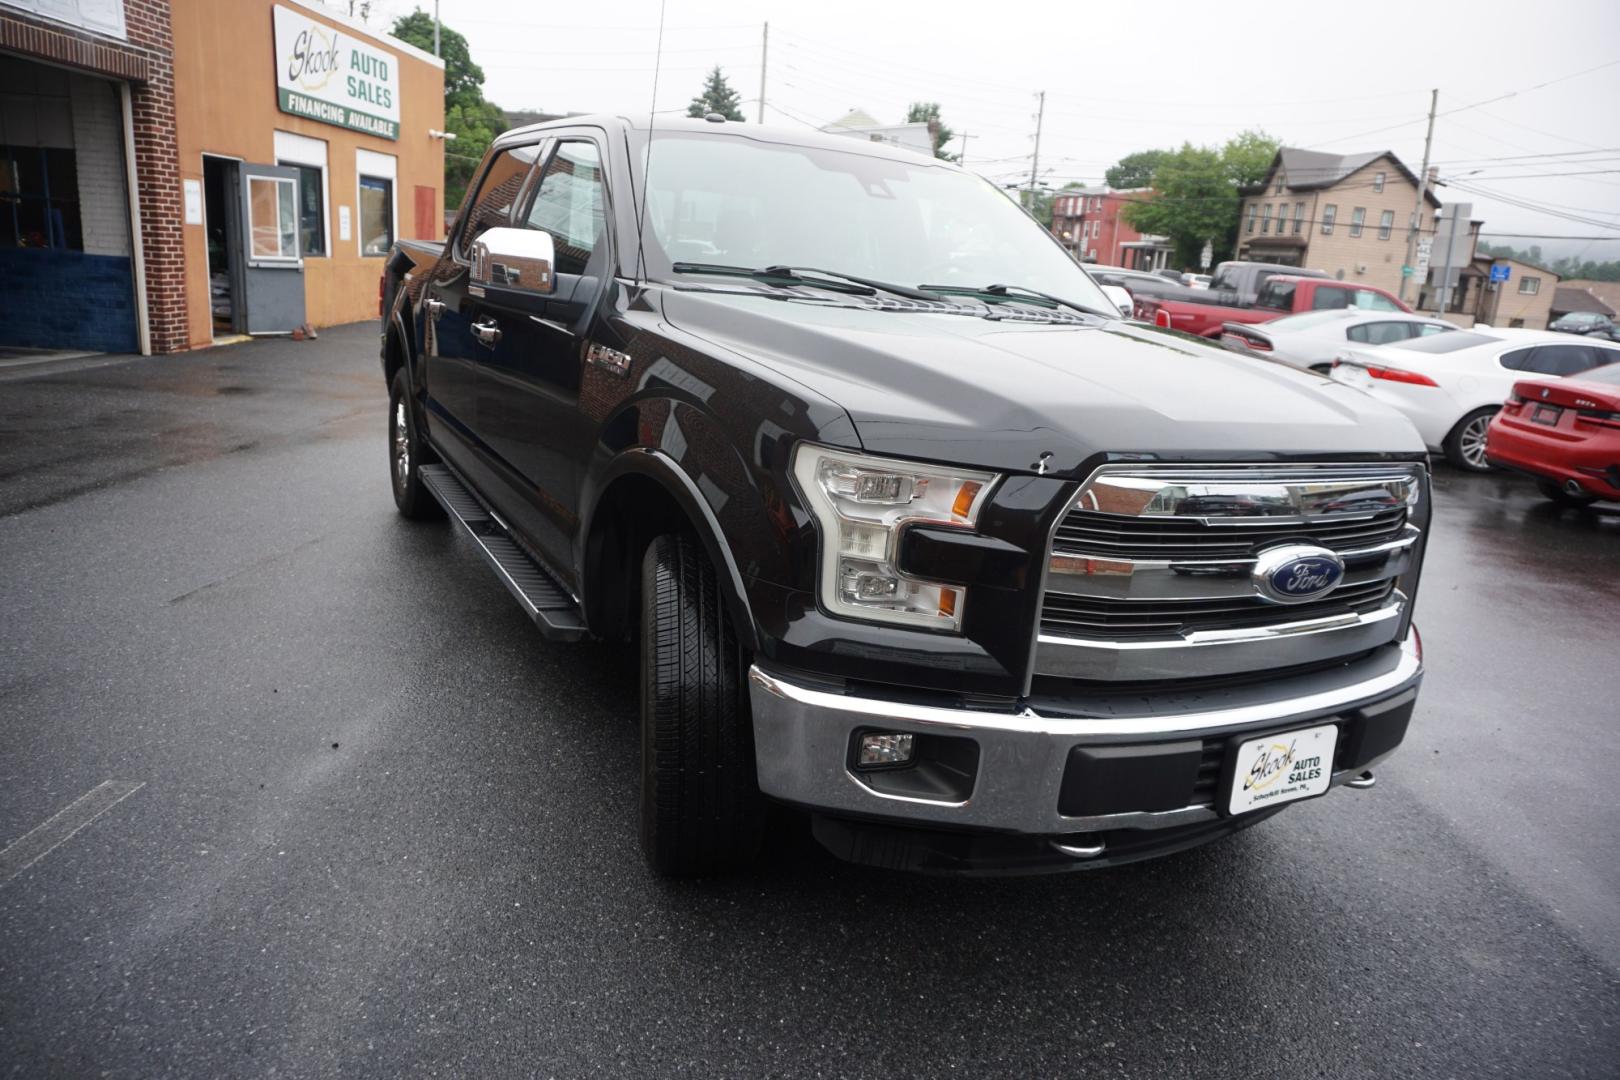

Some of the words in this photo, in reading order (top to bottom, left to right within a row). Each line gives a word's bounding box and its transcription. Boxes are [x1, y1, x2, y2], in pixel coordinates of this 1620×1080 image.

[288, 30, 339, 82] Skook
[350, 48, 388, 82] AUTO
[347, 75, 392, 109] SALES
[288, 93, 345, 124] FINANCING
[348, 111, 394, 137] AVAILABLE
[1287, 563, 1330, 591] Ford
[1243, 739, 1297, 791] Skook
[1287, 767, 1322, 784] SALES
[1293, 756, 1320, 771] AUTO
